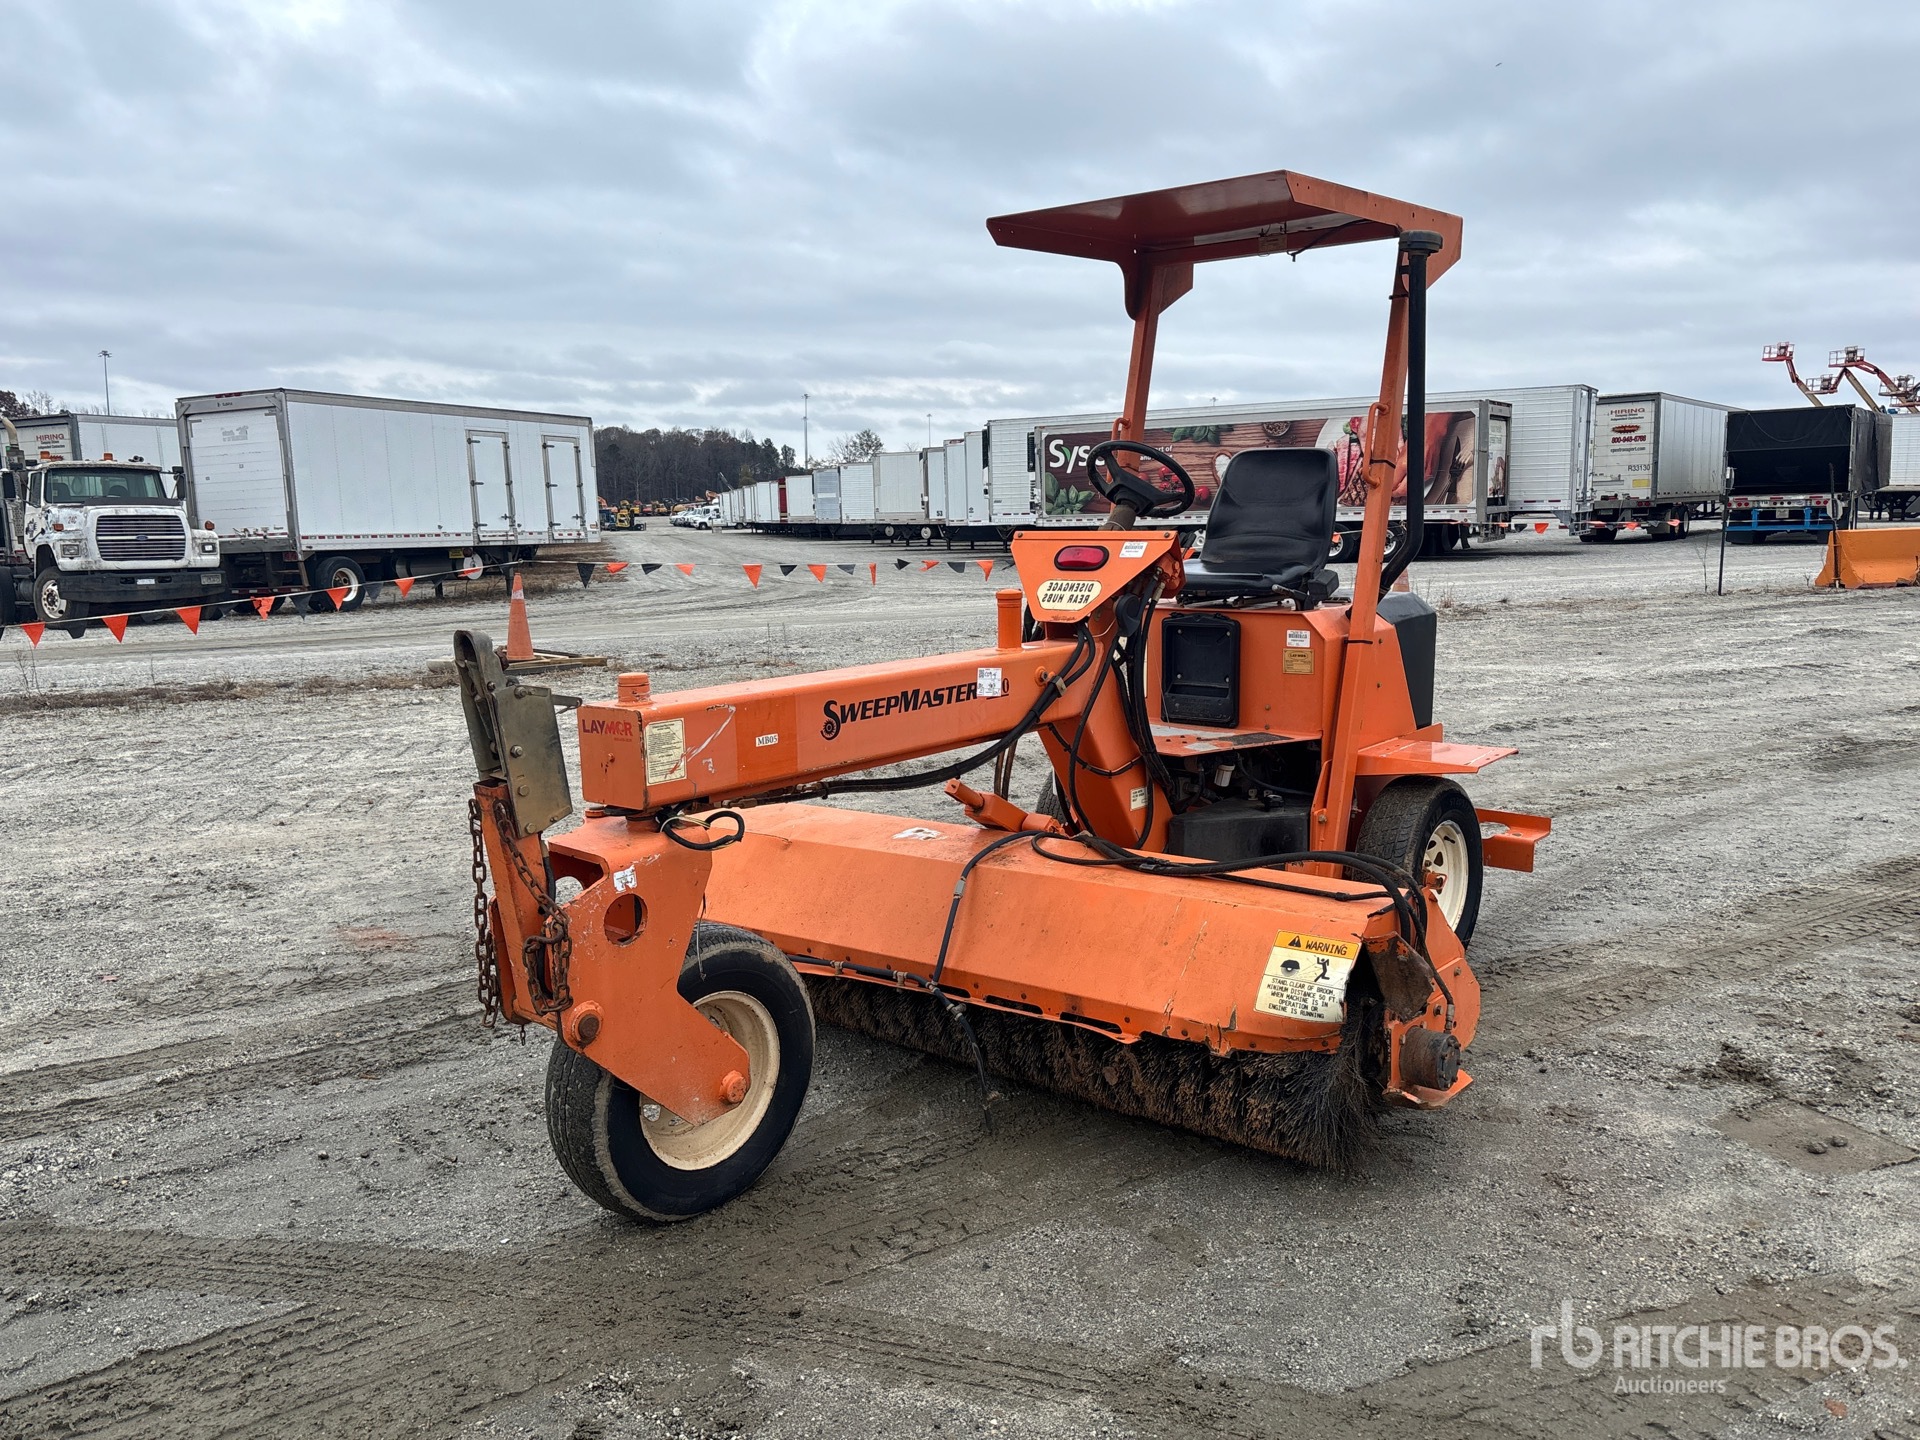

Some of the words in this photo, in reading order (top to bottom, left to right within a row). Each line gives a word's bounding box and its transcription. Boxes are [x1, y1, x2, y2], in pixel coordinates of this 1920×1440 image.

[35, 433, 65, 441] HIRING
[1048, 439, 1106, 474] Sys
[1627, 464, 1651, 472] R33130
[581, 718, 634, 737] LAYMOR
[757, 734, 778, 746] MB05
[1305, 940, 1348, 956] WARNING
[1266, 983, 1289, 992] MINIMUM
[1290, 988, 1316, 998] DISTANCE
[1288, 979, 1305, 989] CLEAR
[1270, 991, 1284, 999] WHEN
[1285, 994, 1309, 1004] MACHINE
[1268, 1003, 1288, 1013] ENGINE
[1299, 1010, 1325, 1019] RUNNING
[1278, 999, 1309, 1010] OPERATION
